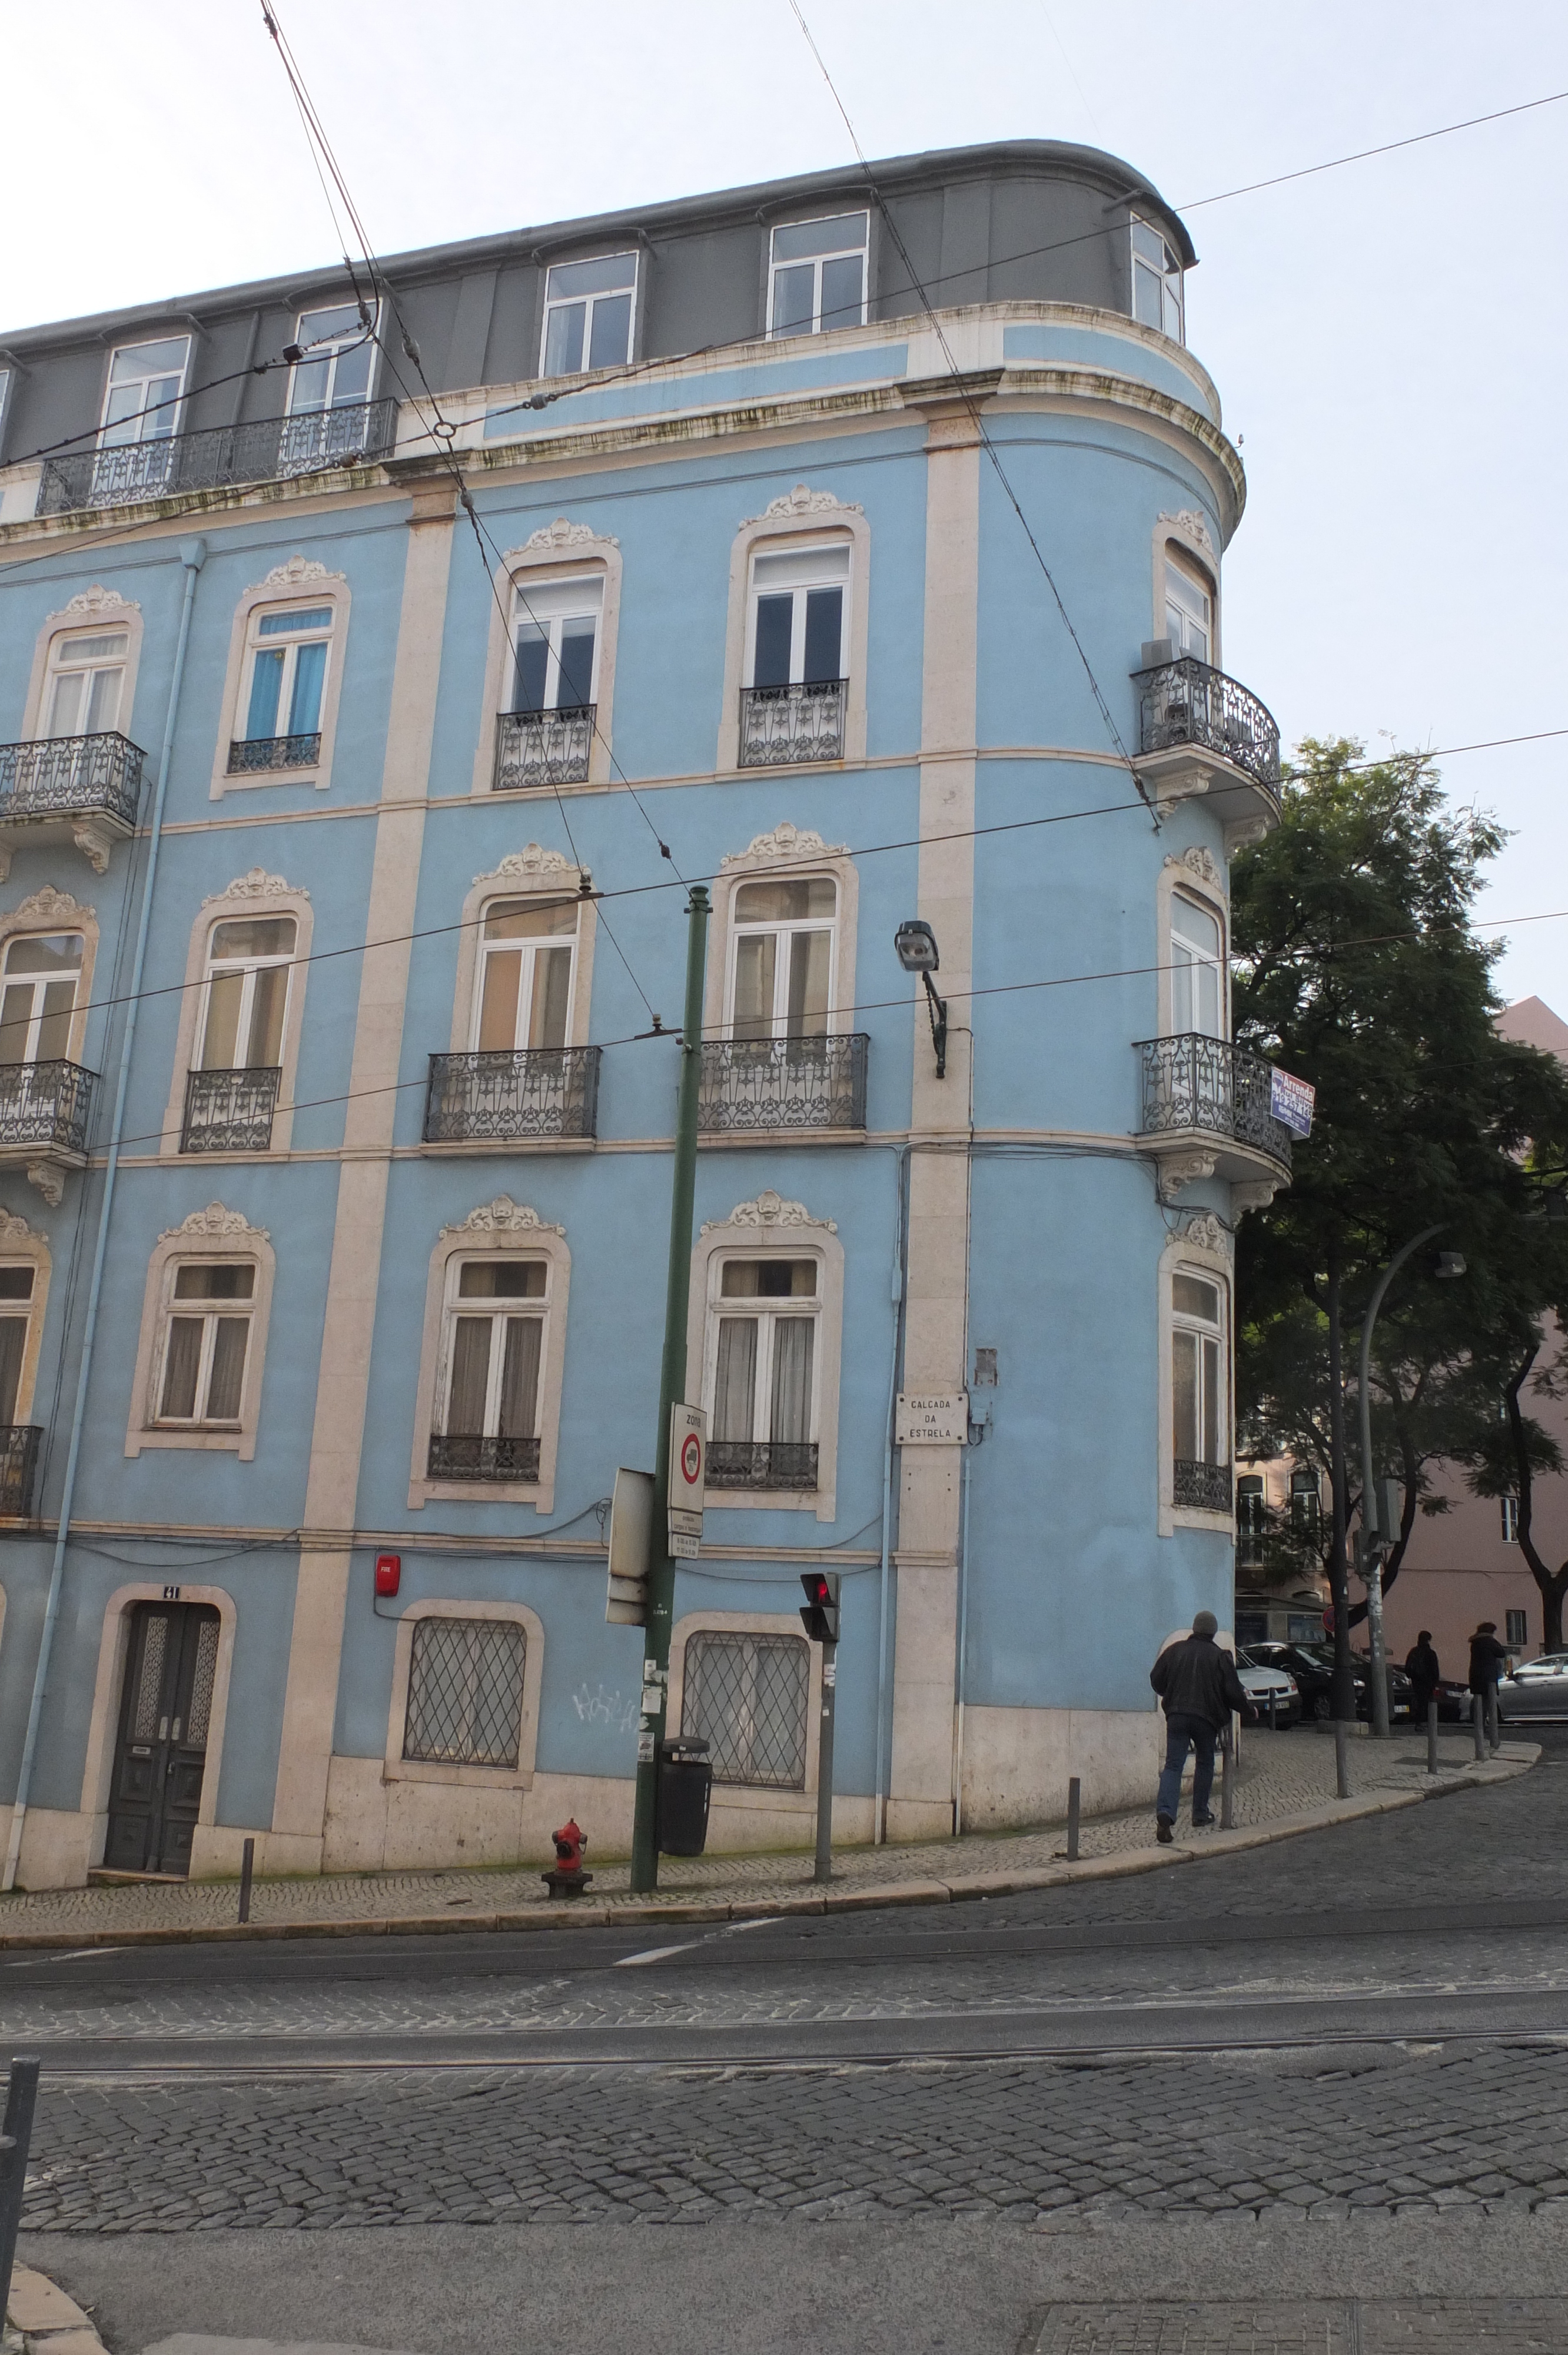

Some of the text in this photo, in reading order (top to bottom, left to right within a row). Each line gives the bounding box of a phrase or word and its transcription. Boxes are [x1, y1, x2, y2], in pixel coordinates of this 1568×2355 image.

[1283, 1075, 1313, 1102] Arrenda
[1273, 1090, 1285, 1103] 919
[1287, 1099, 1299, 1111] 257
[686, 1414, 701, 1428] zona
[925, 1414, 936, 1423] DA
[910, 1429, 951, 1438] ESTRELA
